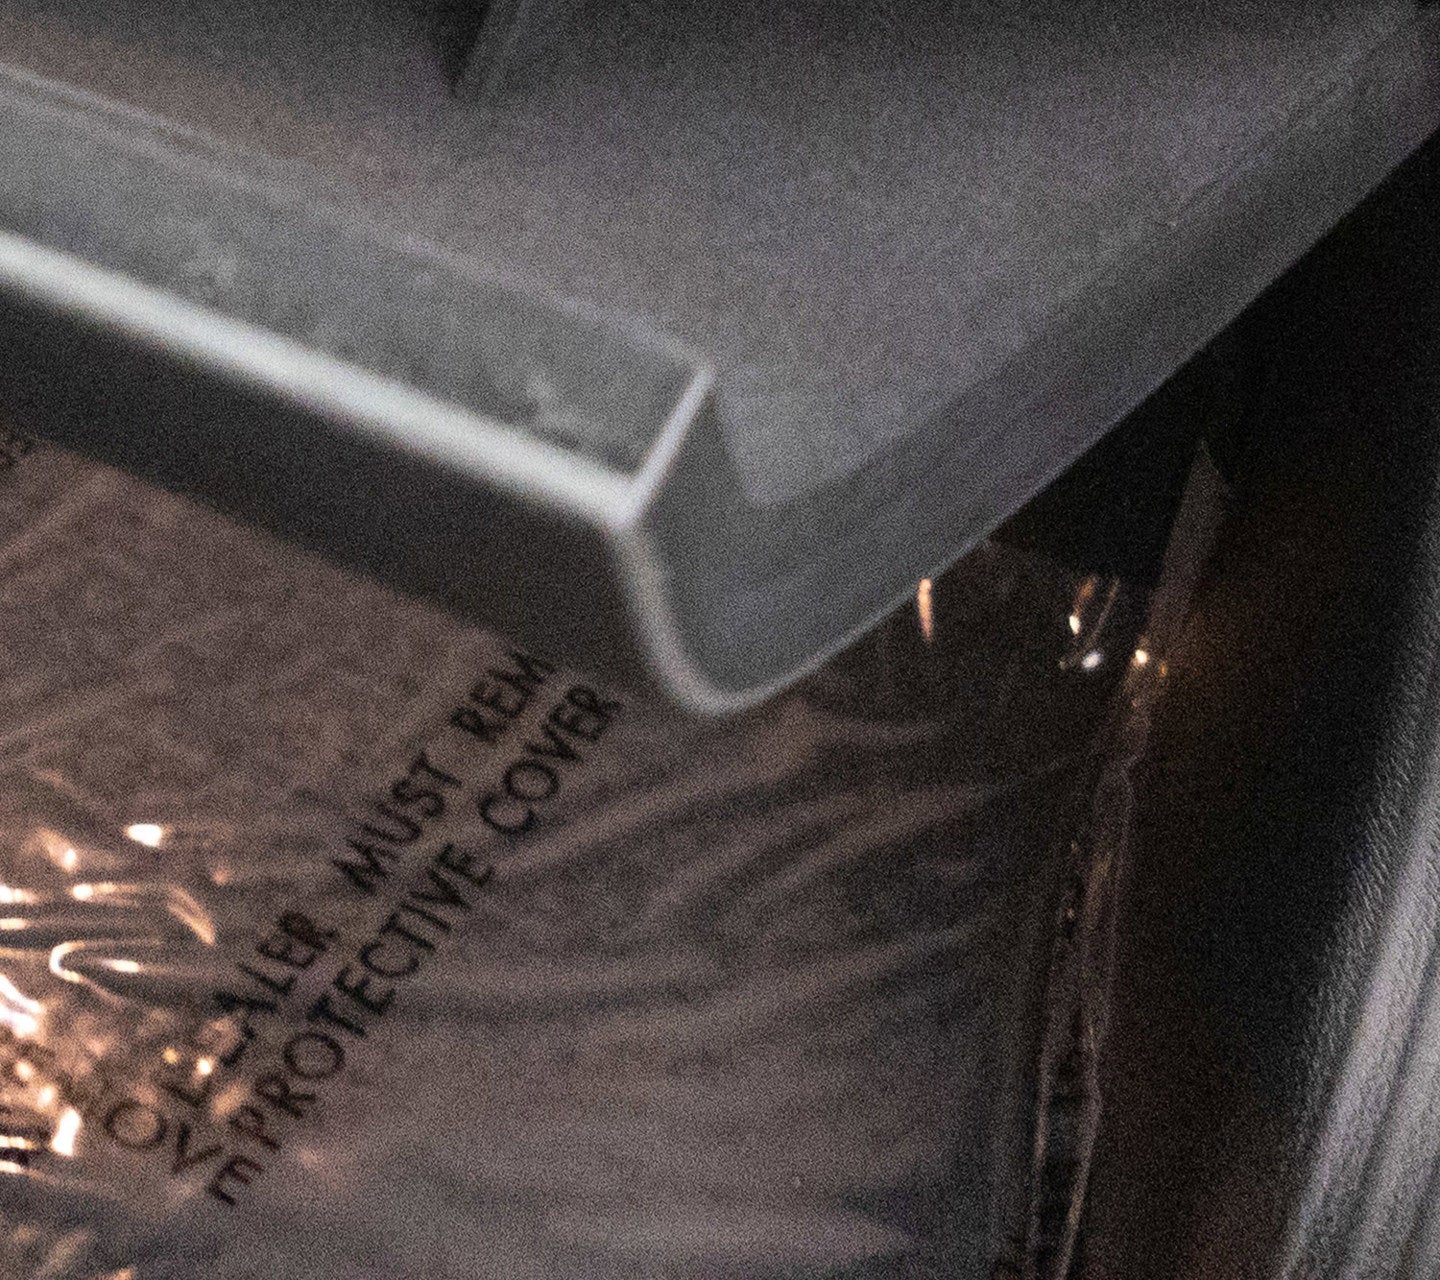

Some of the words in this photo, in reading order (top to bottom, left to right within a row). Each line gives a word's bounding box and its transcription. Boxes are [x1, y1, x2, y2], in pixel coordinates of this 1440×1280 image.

[330, 750, 464, 894] MUST
[474, 683, 622, 842] COVER
[225, 842, 498, 1154] PROTECTIVE
